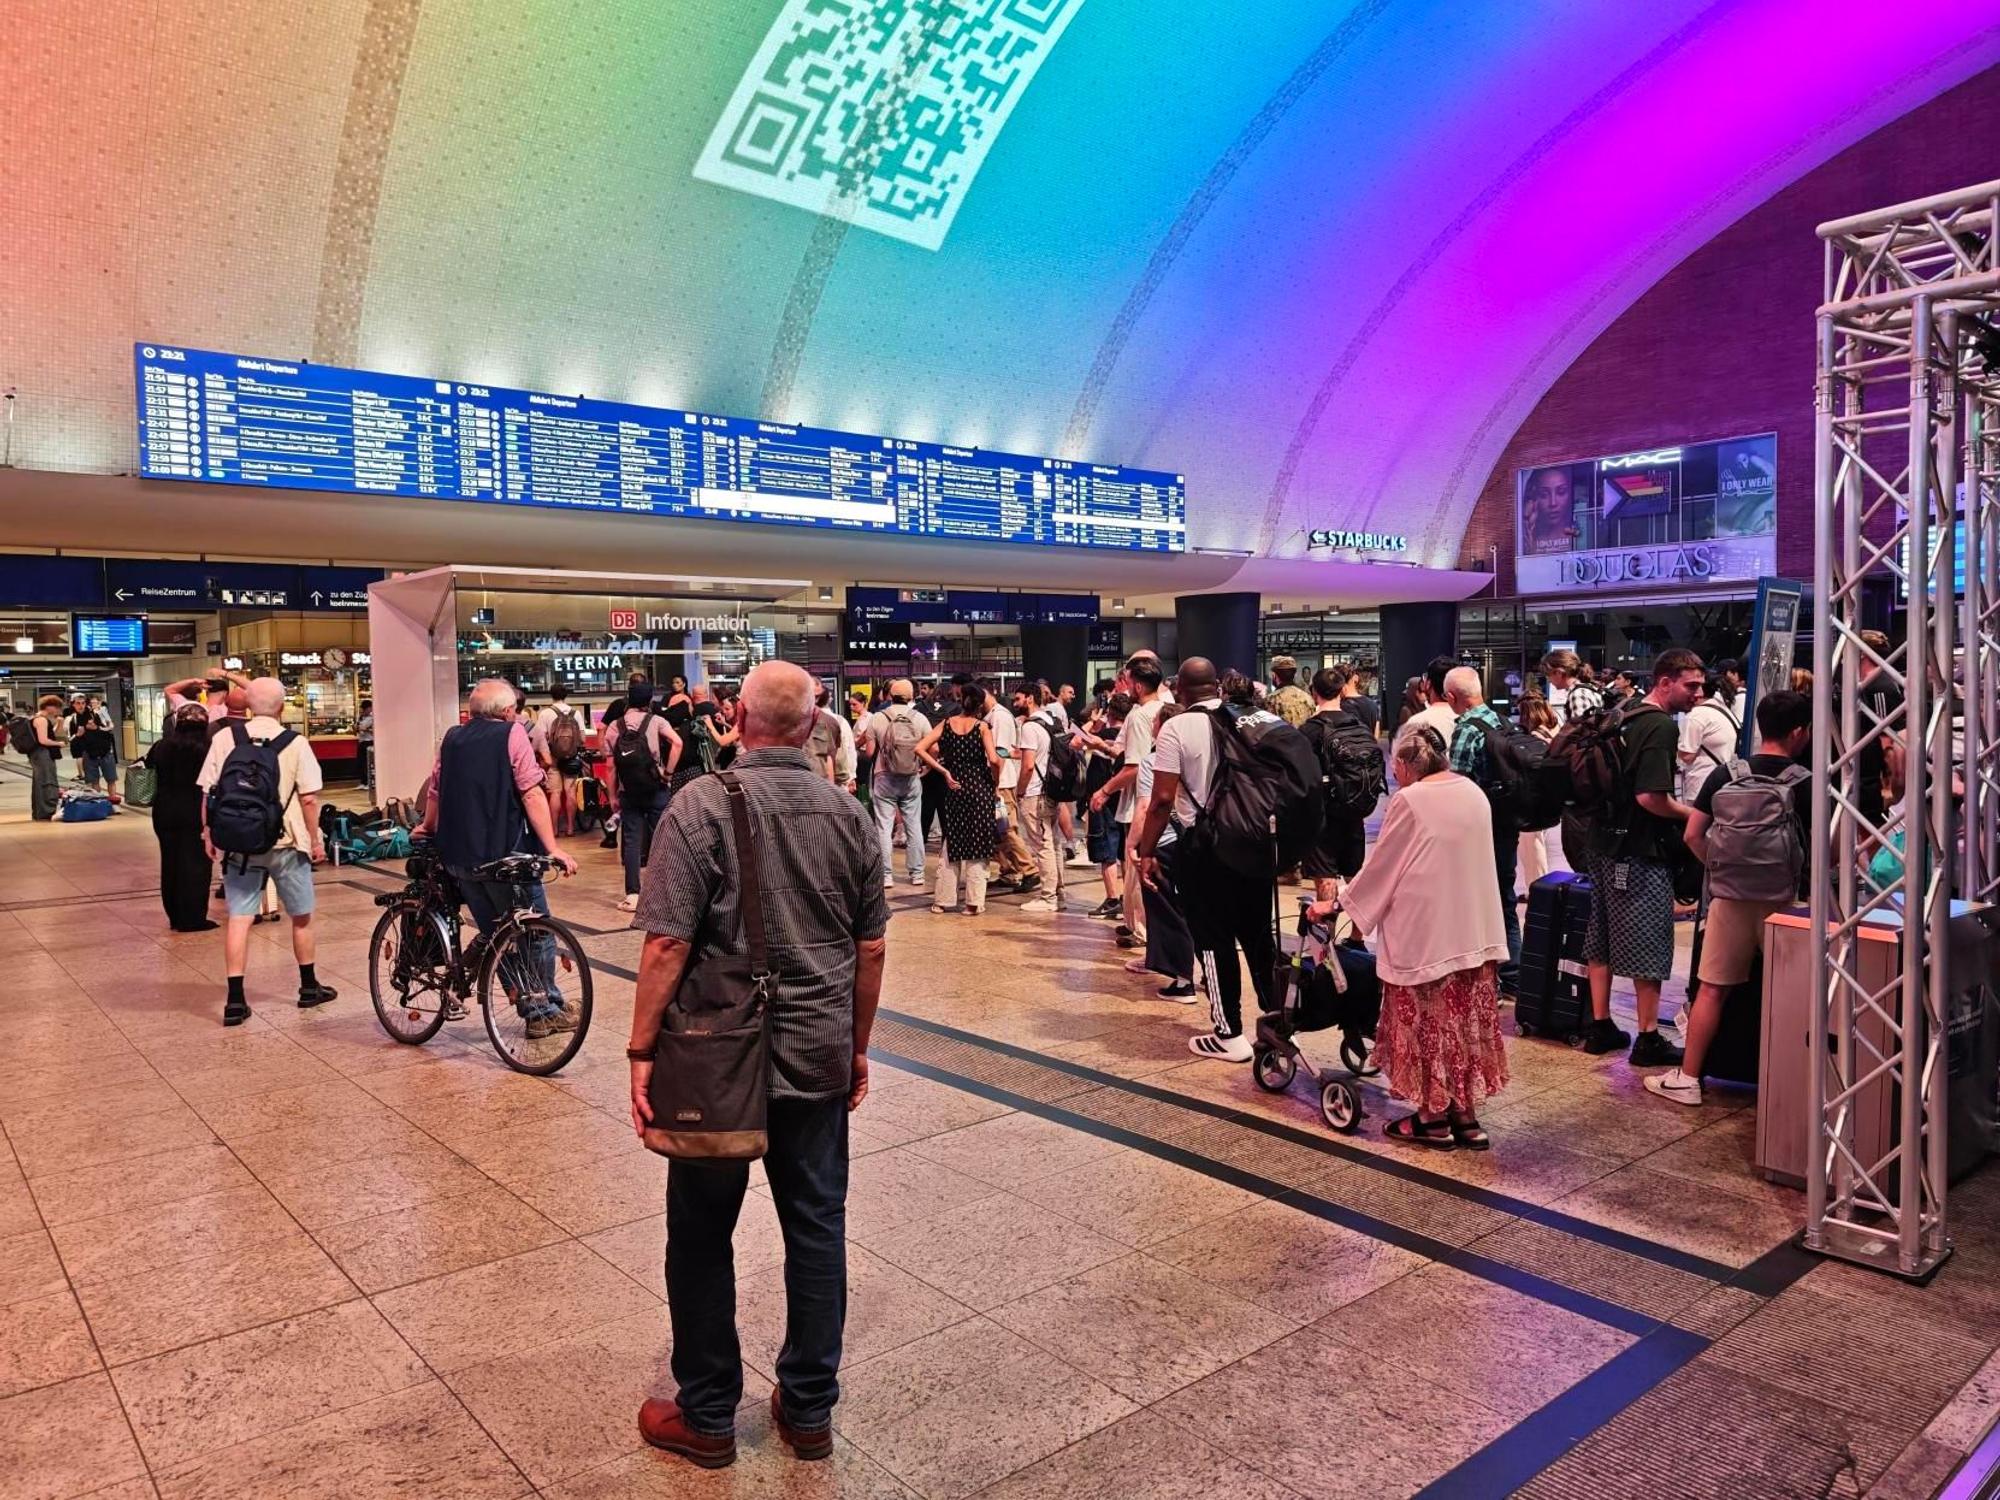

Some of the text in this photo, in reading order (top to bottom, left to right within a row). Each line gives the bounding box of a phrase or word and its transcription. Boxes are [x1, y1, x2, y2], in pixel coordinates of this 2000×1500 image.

[1726, 480, 1746, 491] ONLY
[1749, 477, 1773, 488] WEAR
[1328, 530, 1407, 551] STARBUCKS
[1558, 546, 1712, 585] DOUGLAS
[141, 587, 196, 598] ReiseZentrum
[340, 591, 354, 599] den
[613, 612, 750, 631] DB Information
[866, 622, 871, 632] 1
[849, 641, 908, 649] ETERNA
[281, 653, 321, 665] Snack
[555, 655, 622, 671] ETERNA
